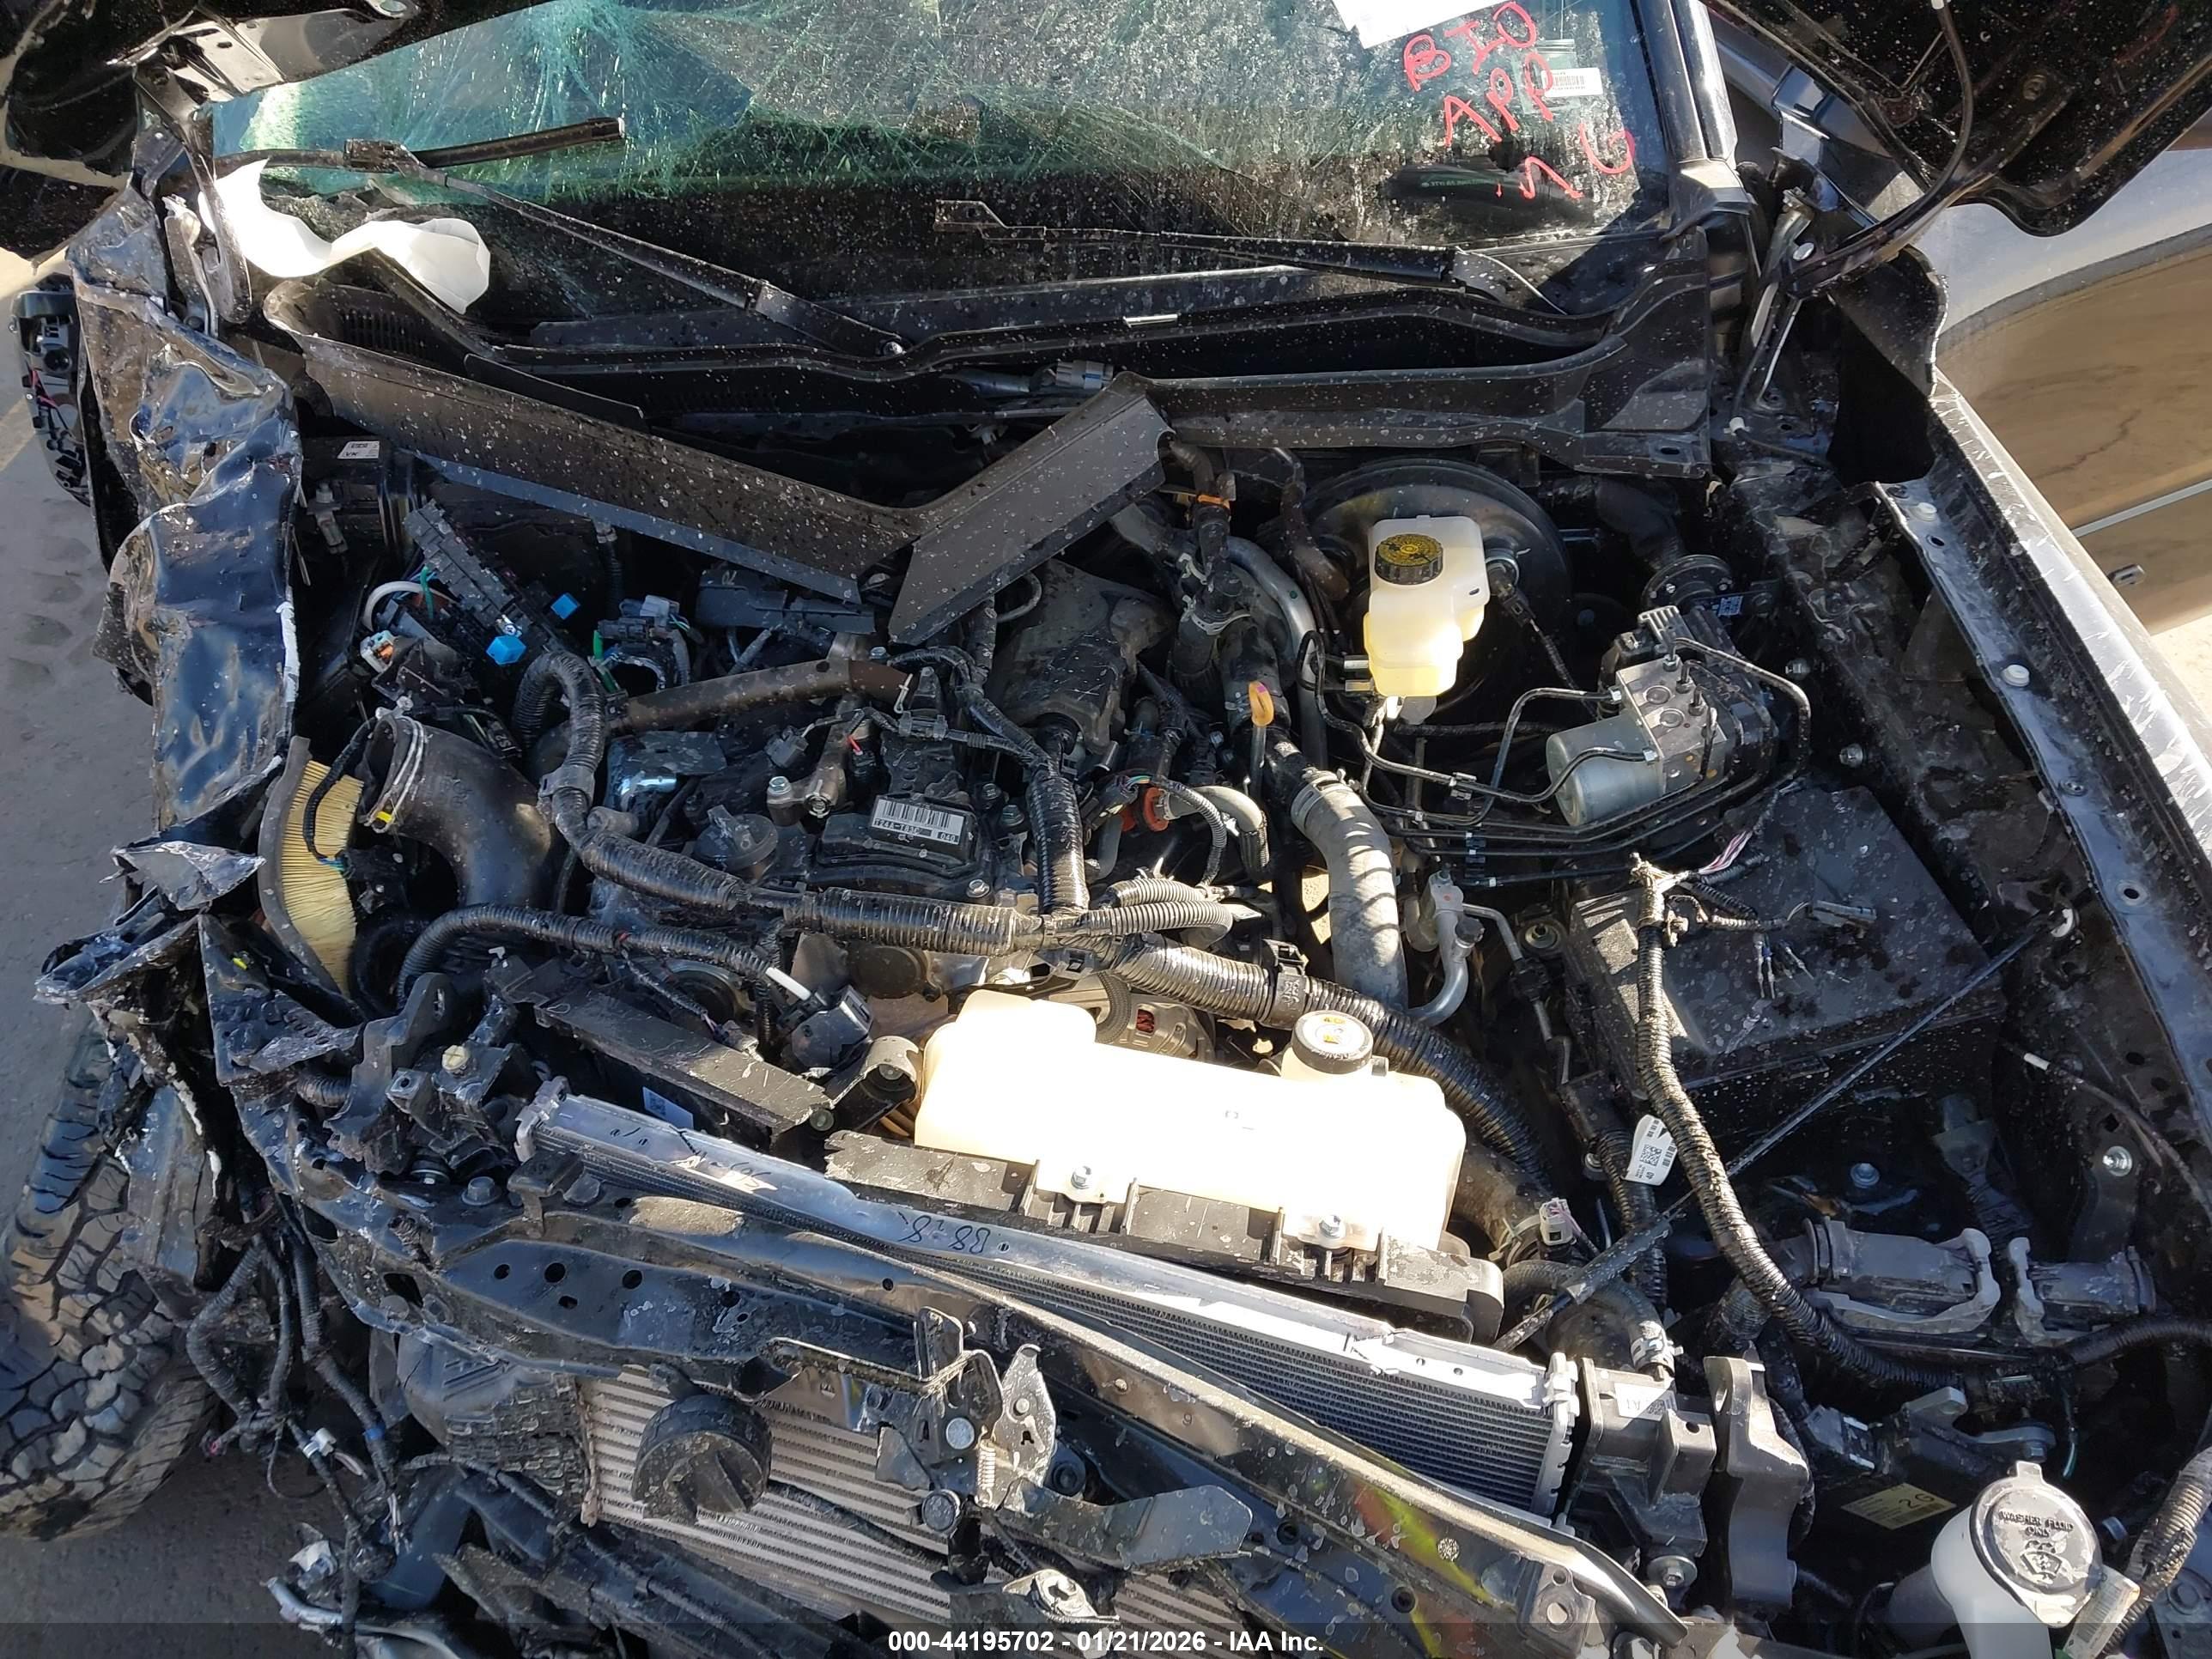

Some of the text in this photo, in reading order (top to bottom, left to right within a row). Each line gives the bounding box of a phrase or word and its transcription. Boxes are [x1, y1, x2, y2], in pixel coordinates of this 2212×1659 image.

[1402, 2, 1537, 92] BIO
[1998, 1511, 2074, 1532] WASHER FLUID
